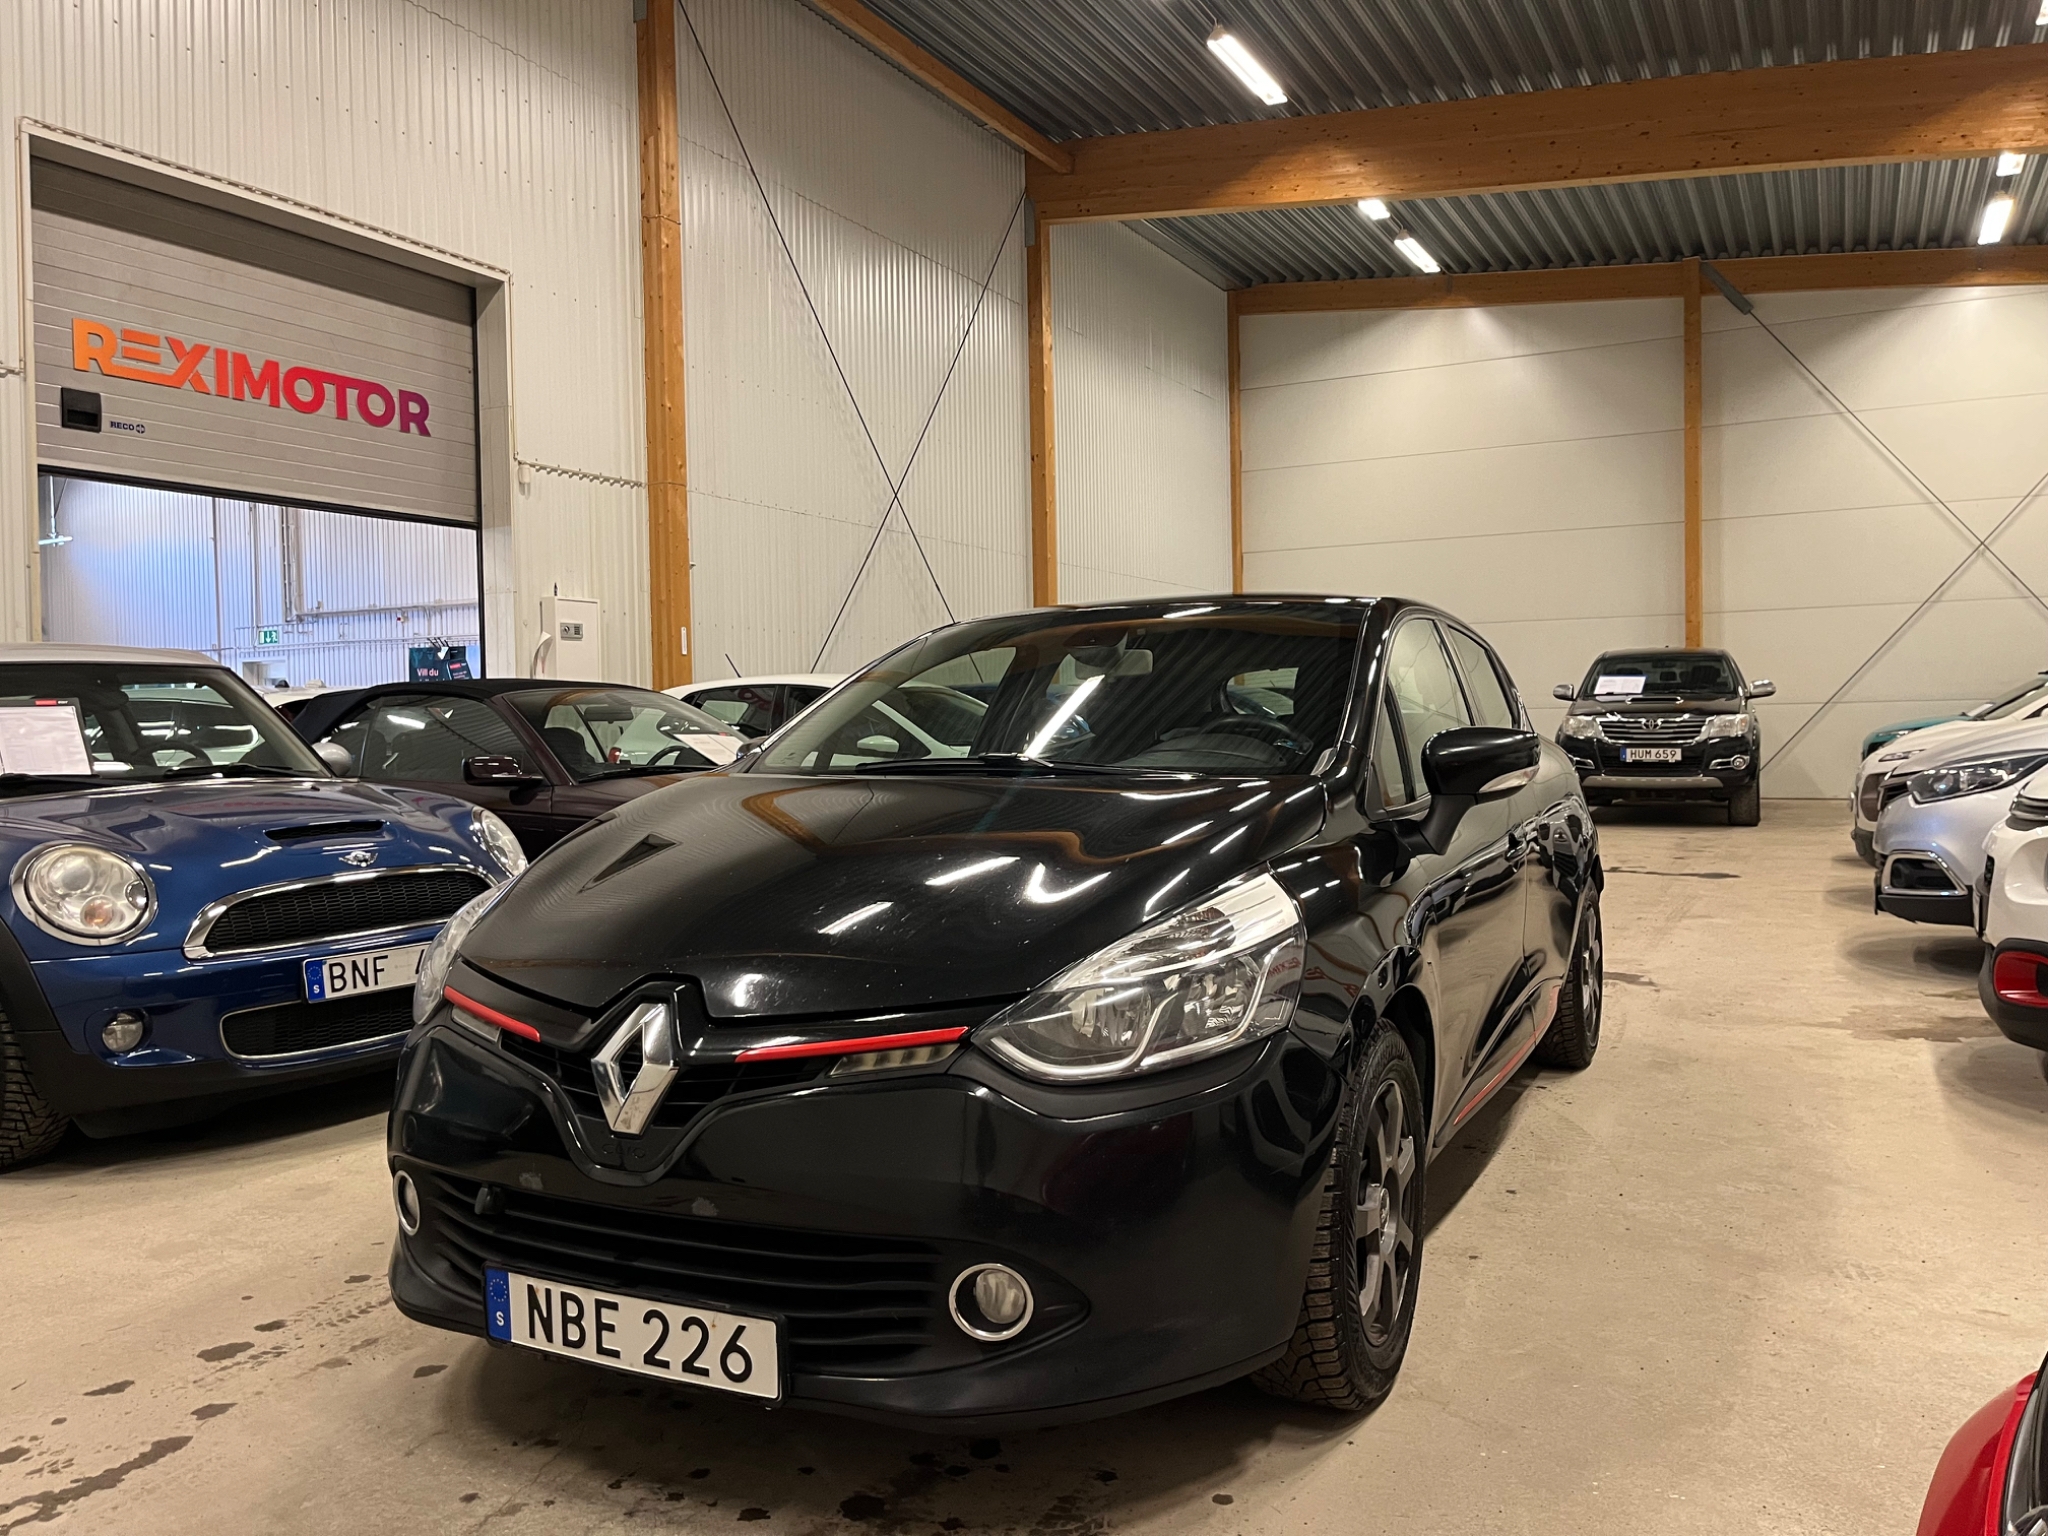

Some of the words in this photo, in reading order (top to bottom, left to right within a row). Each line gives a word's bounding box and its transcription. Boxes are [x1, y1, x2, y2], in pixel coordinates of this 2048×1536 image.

[72, 317, 432, 438] REXIMOTOR
[110, 420, 135, 431] RECO
[429, 668, 439, 677] du
[1630, 749, 1652, 759] HUM
[1655, 749, 1677, 759] 659
[328, 954, 389, 994] BNF
[313, 984, 320, 994] S
[496, 1311, 505, 1327] S
[526, 1283, 621, 1360] NBE
[642, 1308, 753, 1384] 226
